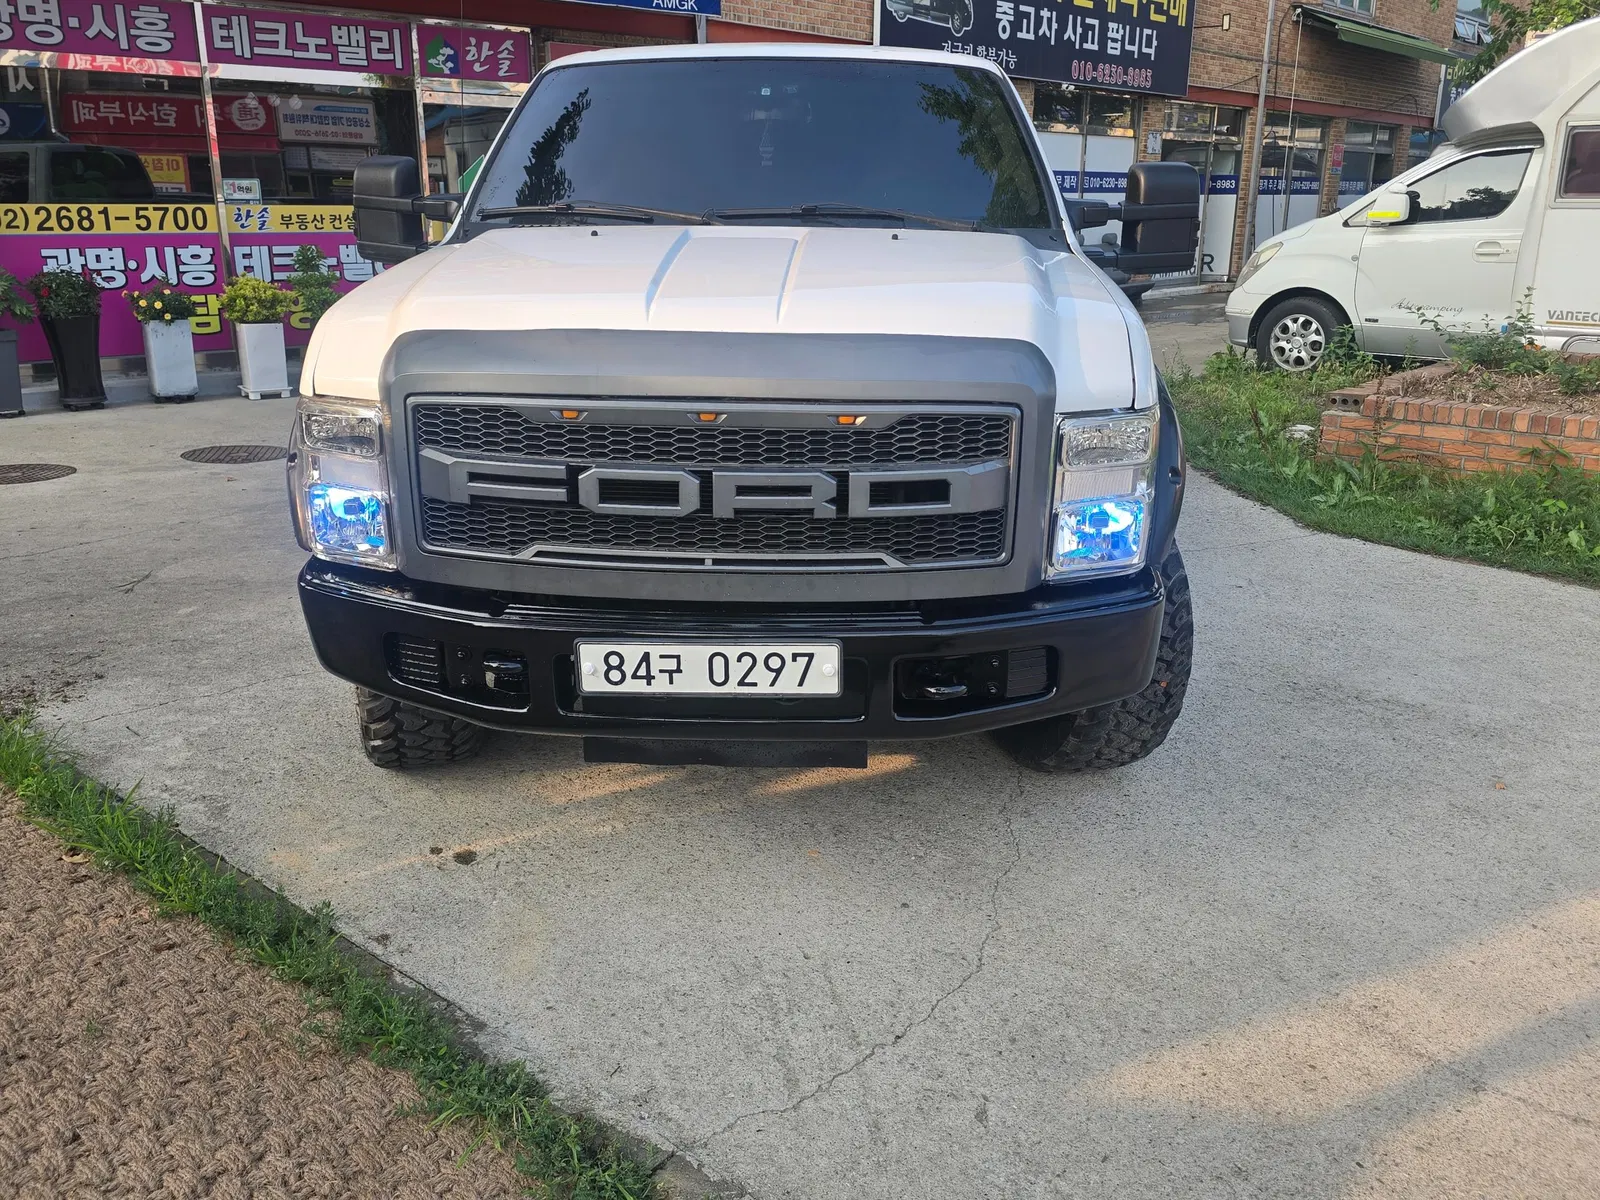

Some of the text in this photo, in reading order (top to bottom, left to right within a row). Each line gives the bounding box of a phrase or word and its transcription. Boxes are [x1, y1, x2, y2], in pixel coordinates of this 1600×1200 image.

[210, 15, 403, 70] 테크노밸리
[996, 1, 1058, 46] 중고차
[1064, 14, 1099, 51] 사고
[1107, 21, 1157, 61] 팝니다
[465, 36, 517, 76] 한솔
[1071, 59, 1153, 88] 010-6230-8983
[0, 205, 208, 232] 2)2681-5700
[233, 207, 271, 231] 한솔
[280, 214, 326, 230] 부동산
[1548, 309, 1600, 322] VANTEC
[419, 449, 1010, 519] FORD
[603, 650, 815, 688] 84구 0297
